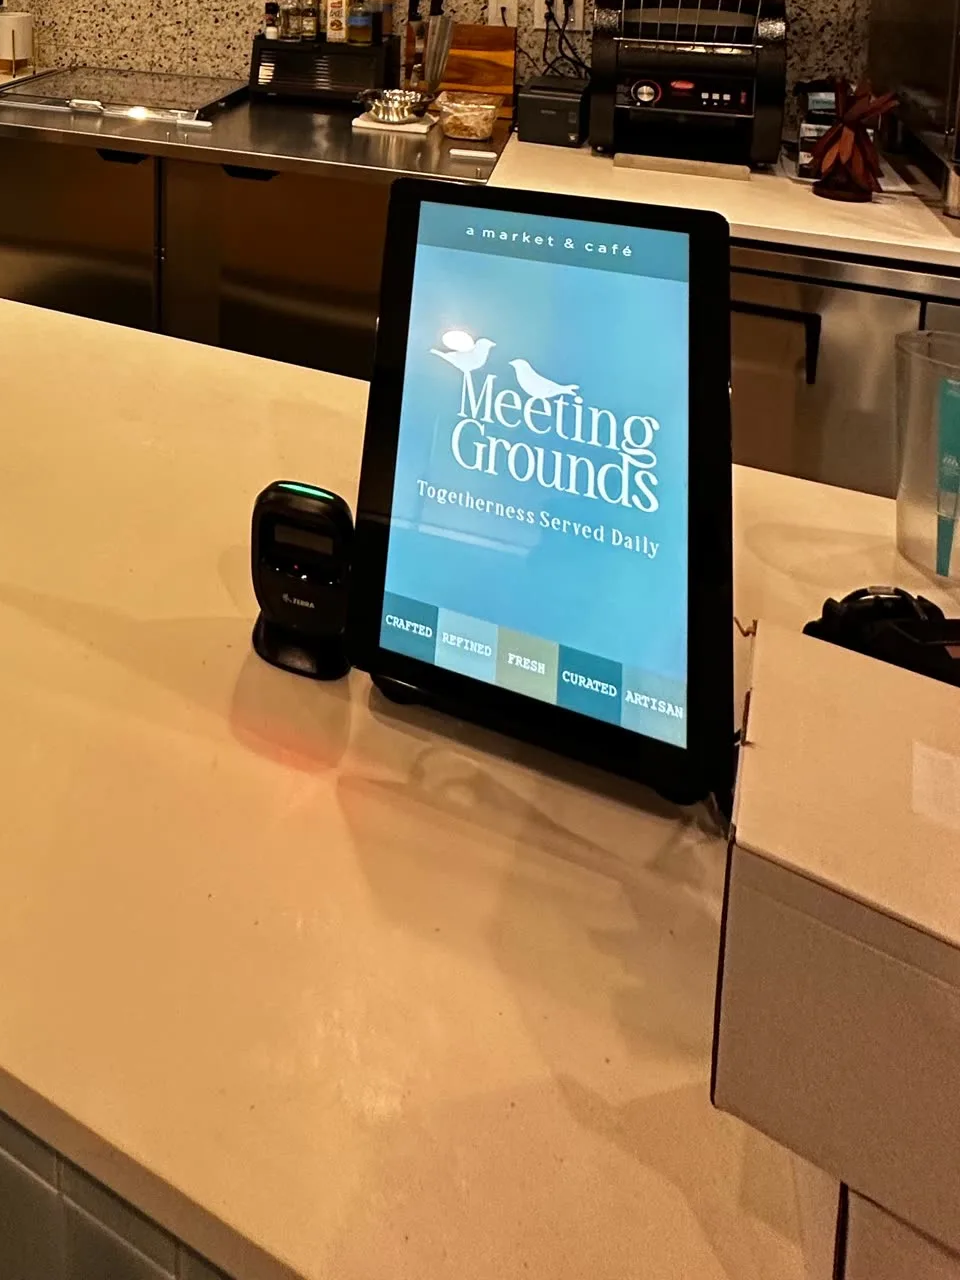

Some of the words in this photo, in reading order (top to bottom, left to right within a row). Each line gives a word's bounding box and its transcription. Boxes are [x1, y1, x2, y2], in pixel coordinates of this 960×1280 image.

[466, 227, 475, 236] a
[482, 229, 554, 247] market
[564, 238, 574, 249] &
[584, 242, 632, 257] café
[457, 371, 660, 468] Meeting
[452, 418, 659, 512] Grounds
[417, 479, 535, 524] Togetherness
[540, 510, 605, 543] Served
[612, 528, 660, 559] Daily
[292, 598, 315, 609] ZEBRA
[386, 614, 433, 638] CRAFTED
[442, 632, 492, 657] REFINED
[507, 653, 546, 675] FRESH
[562, 670, 618, 698] CURATED
[625, 690, 683, 720] ARTISAN
